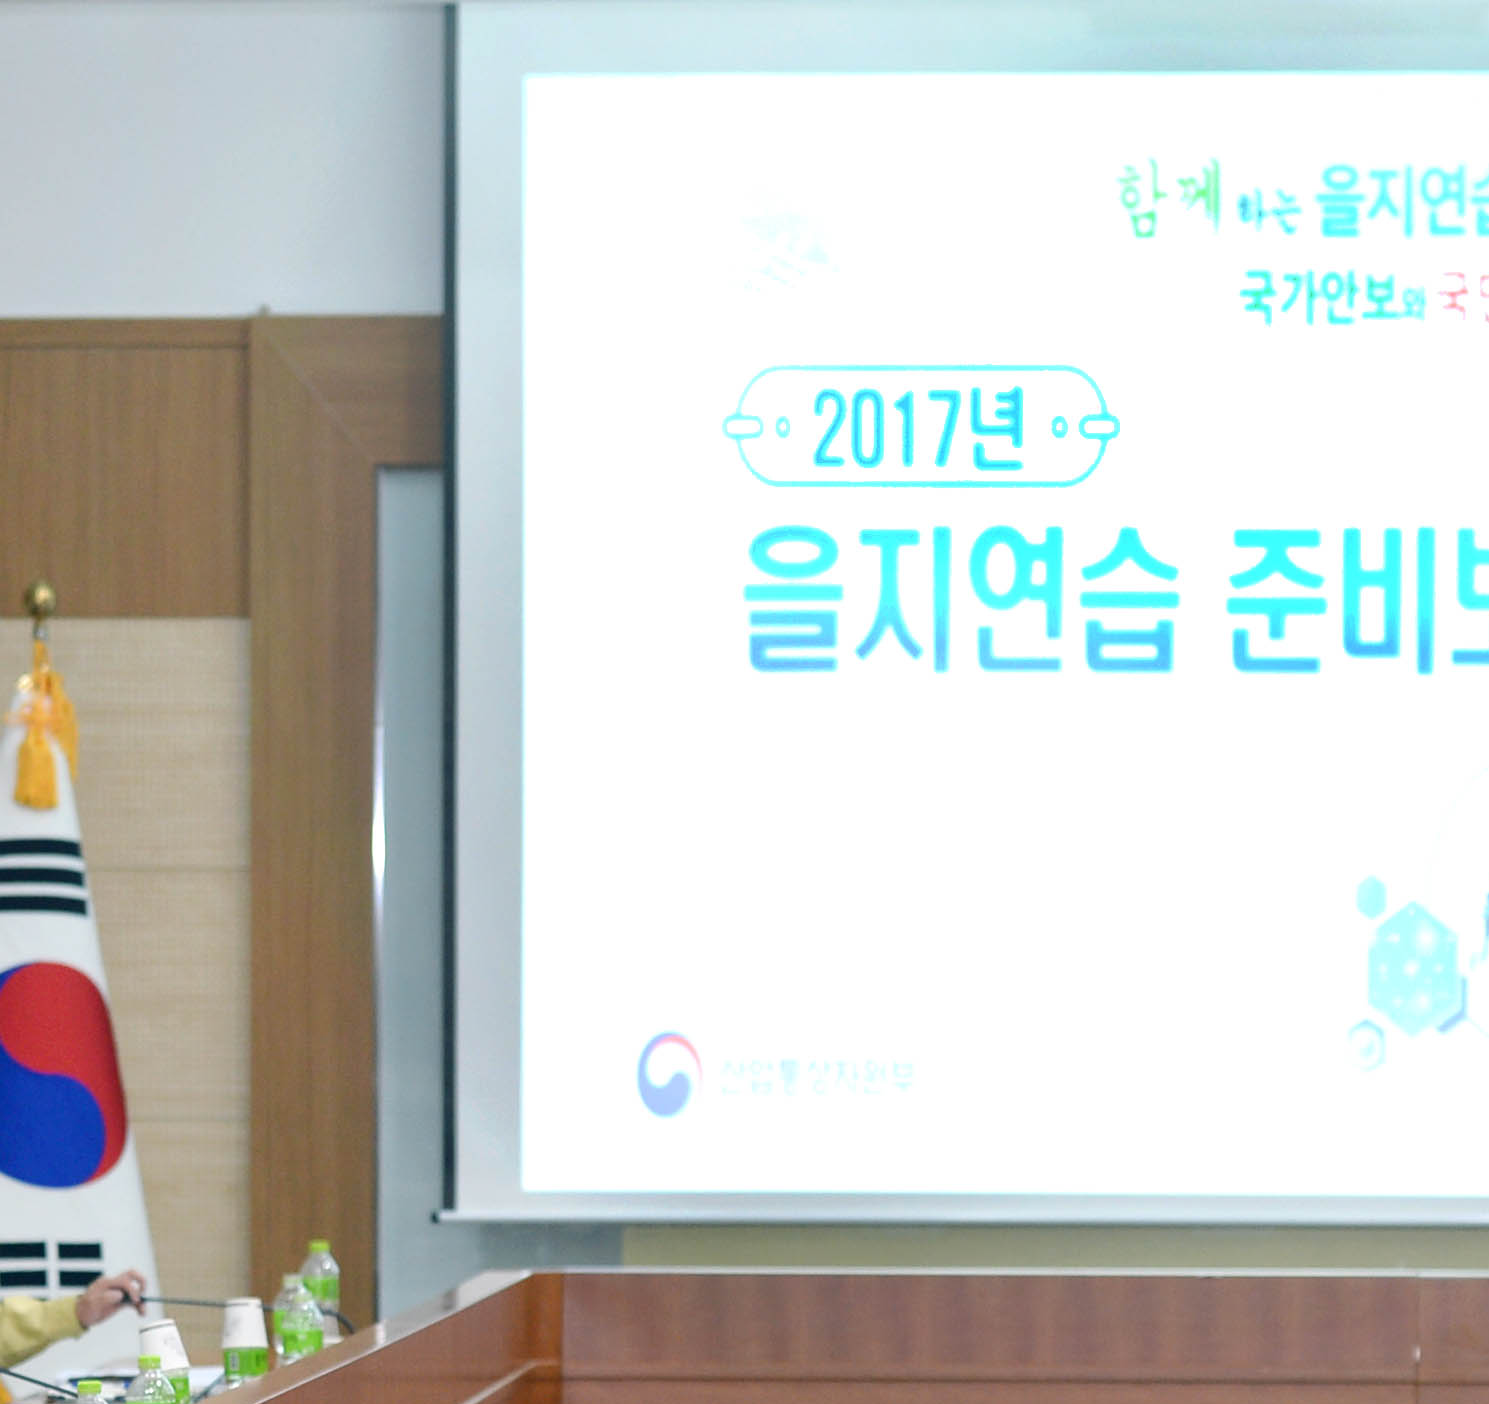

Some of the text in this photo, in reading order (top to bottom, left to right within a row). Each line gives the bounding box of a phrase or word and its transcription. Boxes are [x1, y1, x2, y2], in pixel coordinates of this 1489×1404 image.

[1240, 269, 1427, 327] 국가안보와
[813, 385, 1024, 471] 2017년
[744, 525, 1180, 673] 을지연습
